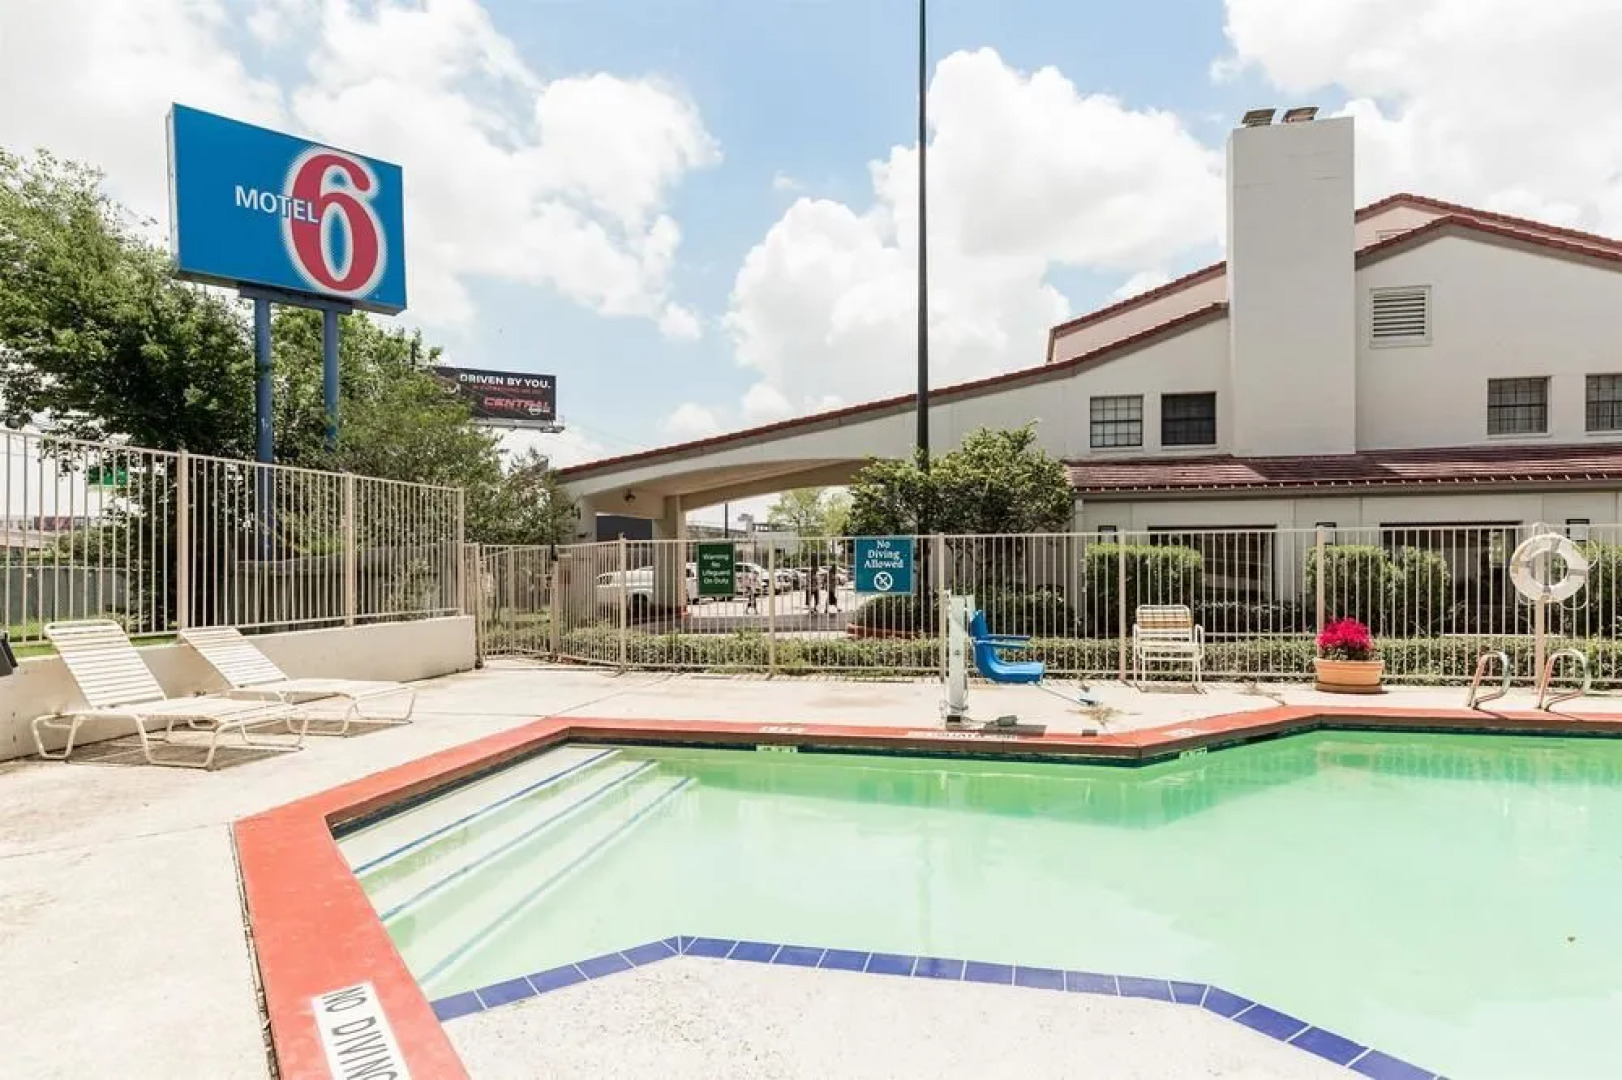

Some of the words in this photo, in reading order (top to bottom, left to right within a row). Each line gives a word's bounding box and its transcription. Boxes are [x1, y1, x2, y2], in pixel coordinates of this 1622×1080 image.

[235, 186, 318, 223] MOTEL
[288, 150, 382, 295] 6
[460, 373, 504, 385] DRIVEN
[507, 377, 522, 387] BY
[524, 378, 551, 389] YOU.
[876, 539, 891, 549] No
[867, 549, 901, 561] Diving
[864, 559, 904, 569] Allowed
[321, 985, 368, 1013] NO
